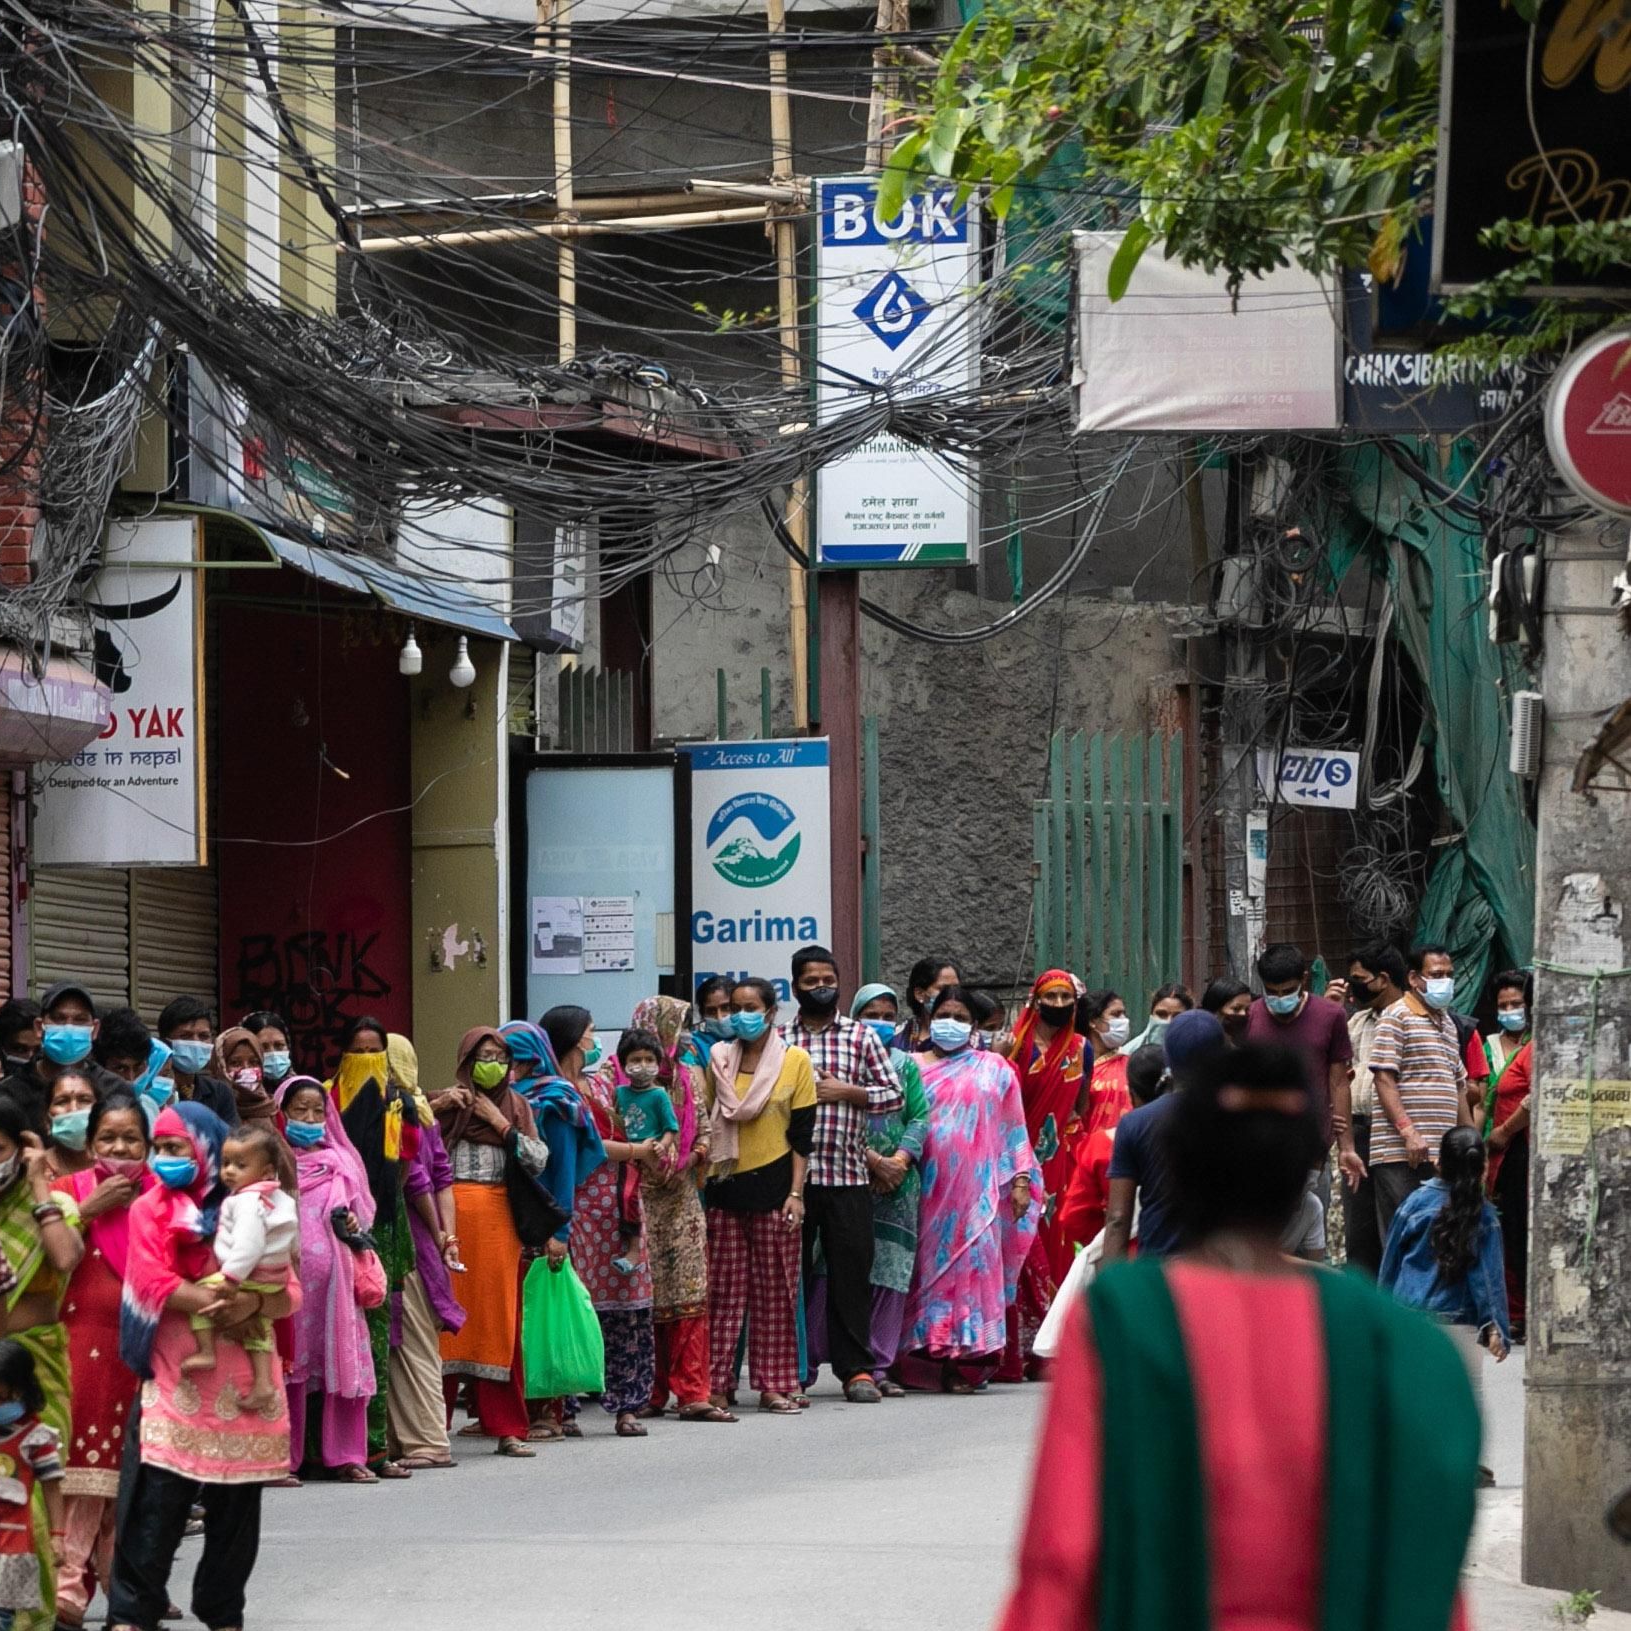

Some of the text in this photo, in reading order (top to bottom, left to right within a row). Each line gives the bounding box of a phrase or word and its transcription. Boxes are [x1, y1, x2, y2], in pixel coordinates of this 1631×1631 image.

[834, 191, 958, 240] BOK
[127, 704, 185, 739] YAK
[105, 748, 123, 766] in
[130, 747, 181, 769] nepal
[756, 752, 770, 764] to
[1278, 755, 1352, 787] HIS
[49, 776, 179, 790] Designed for an Adventure
[691, 909, 818, 944] Garima
